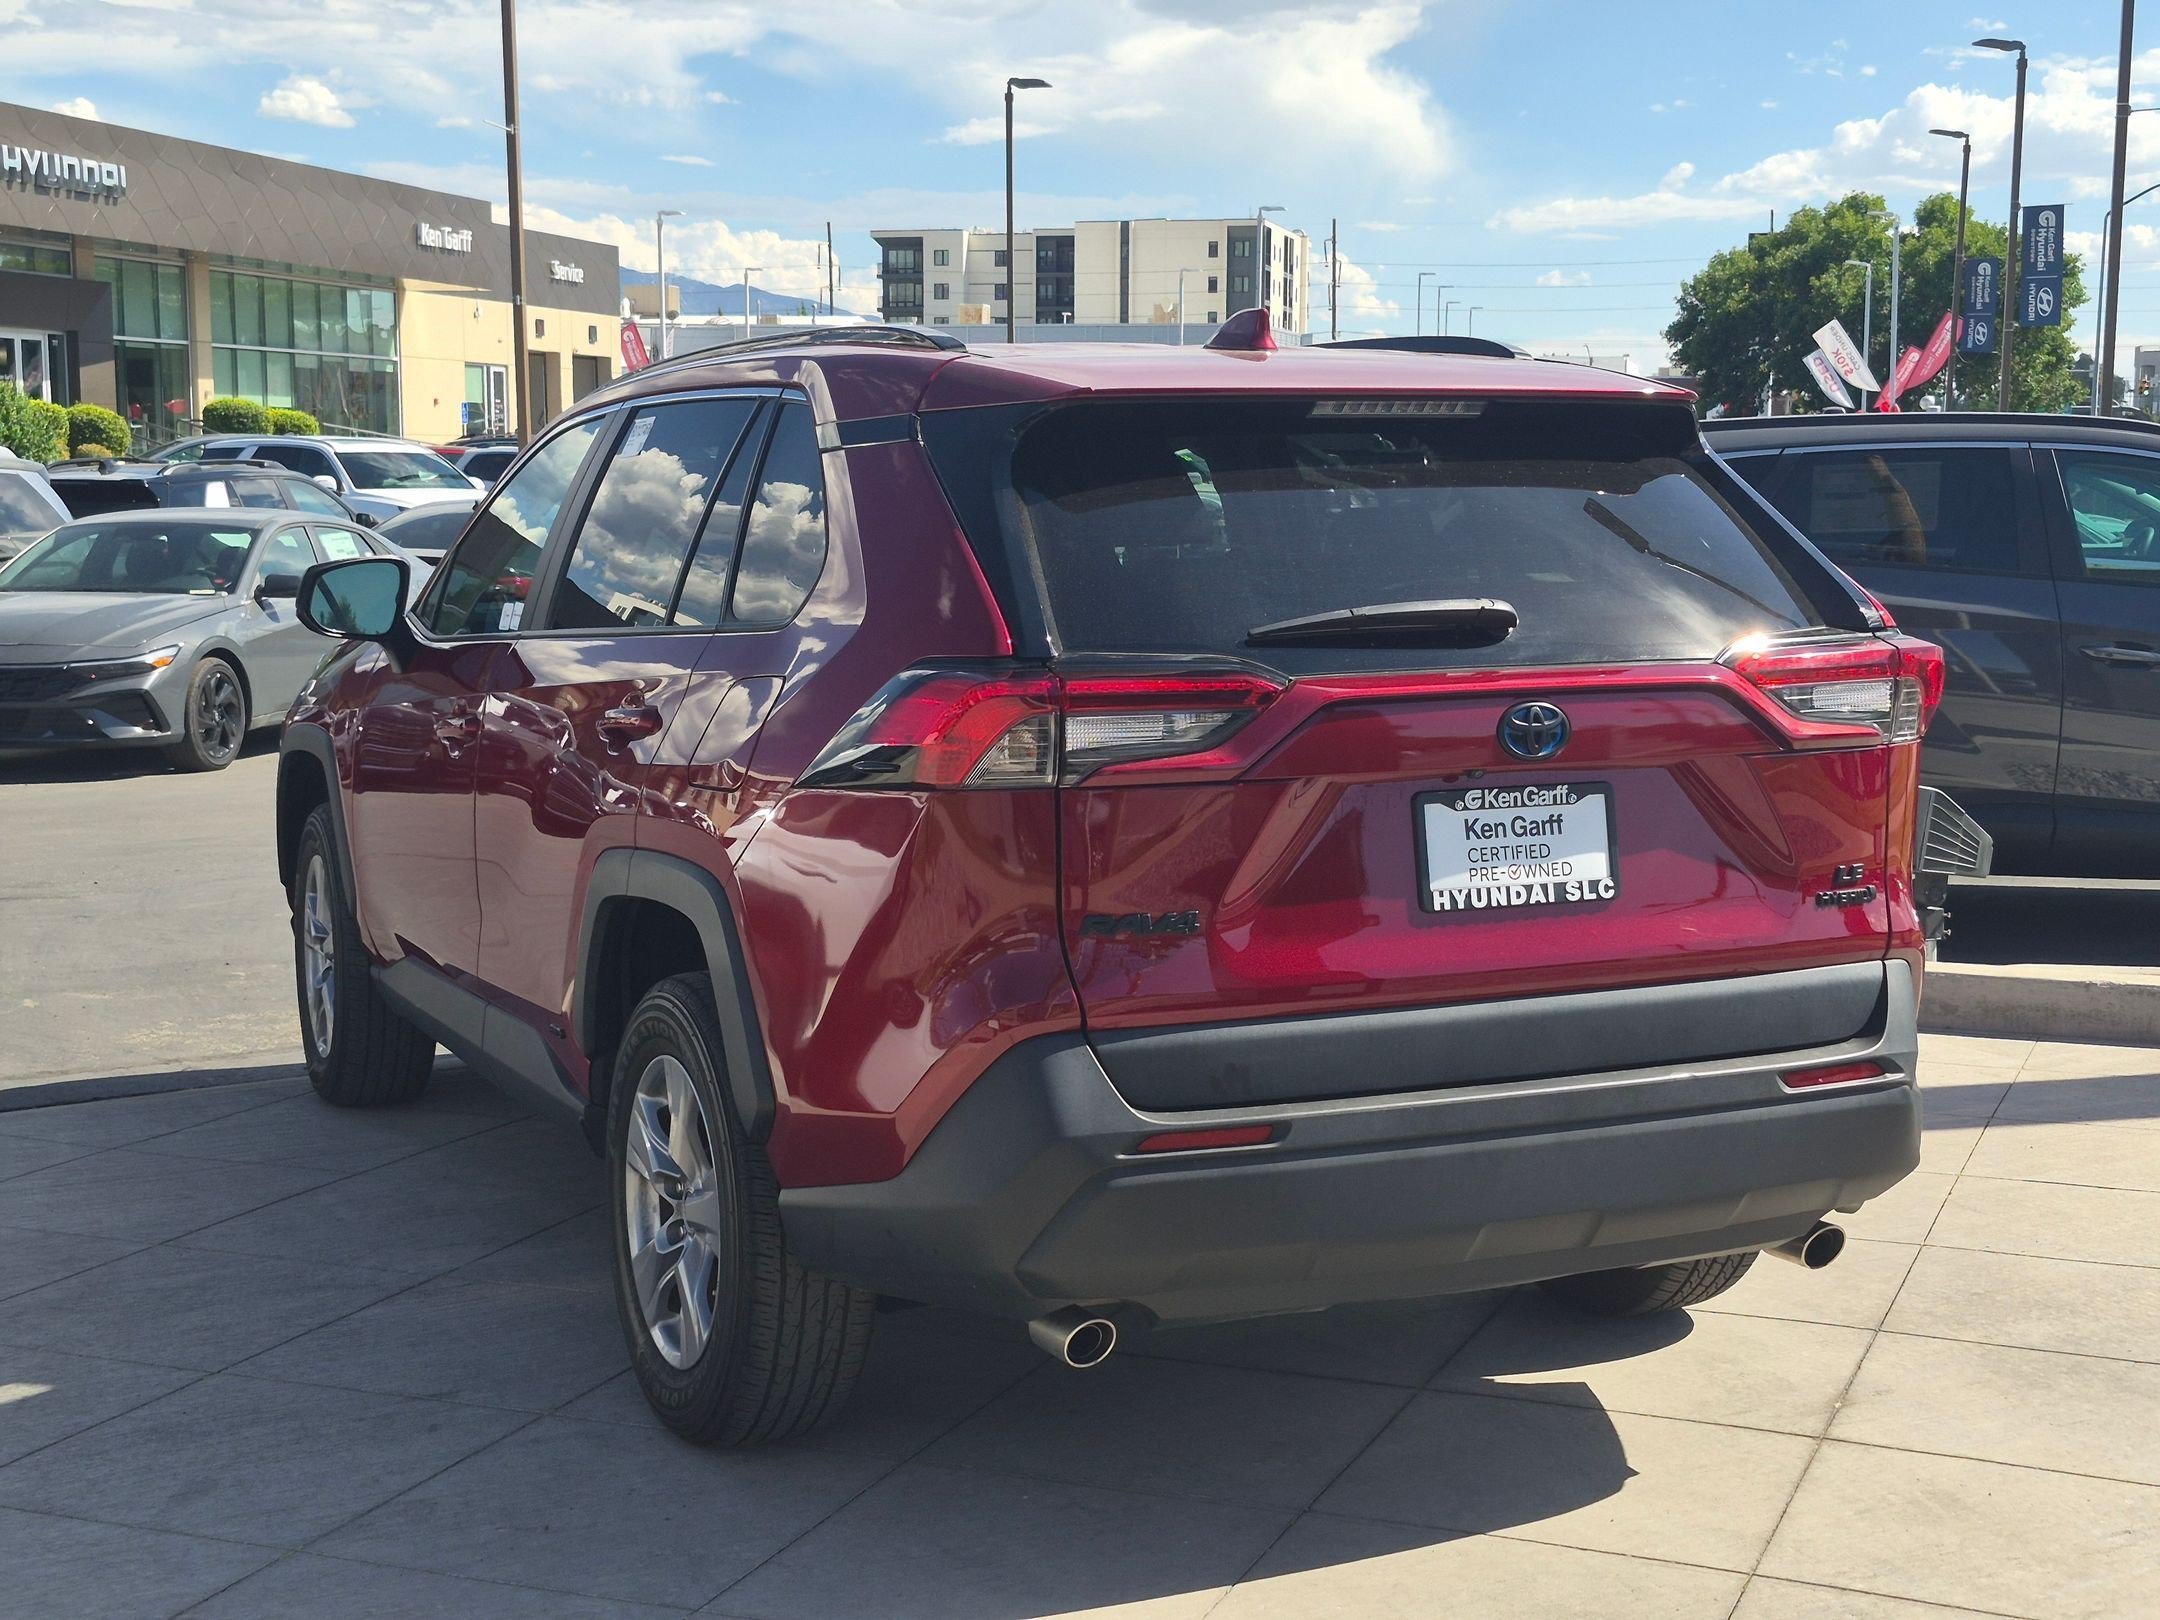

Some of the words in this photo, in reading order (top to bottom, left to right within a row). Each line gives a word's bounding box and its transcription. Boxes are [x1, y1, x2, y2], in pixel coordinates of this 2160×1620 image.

[418, 222, 442, 248] Ken
[441, 227, 473, 252] Garff
[2036, 228, 2048, 271] Hyundai
[551, 259, 584, 283] Service
[1484, 788, 1521, 808] Ken
[1523, 785, 1568, 806] Garff
[1463, 817, 1507, 840] Ken
[1511, 813, 1563, 838] Garff
[1467, 843, 1551, 863] CERTIFIED
[1469, 861, 1573, 883] PRE-OWNED
[1432, 883, 1555, 911] HYUNDAI
[1565, 877, 1615, 901] SLC
[1079, 909, 1200, 937] RAV4
